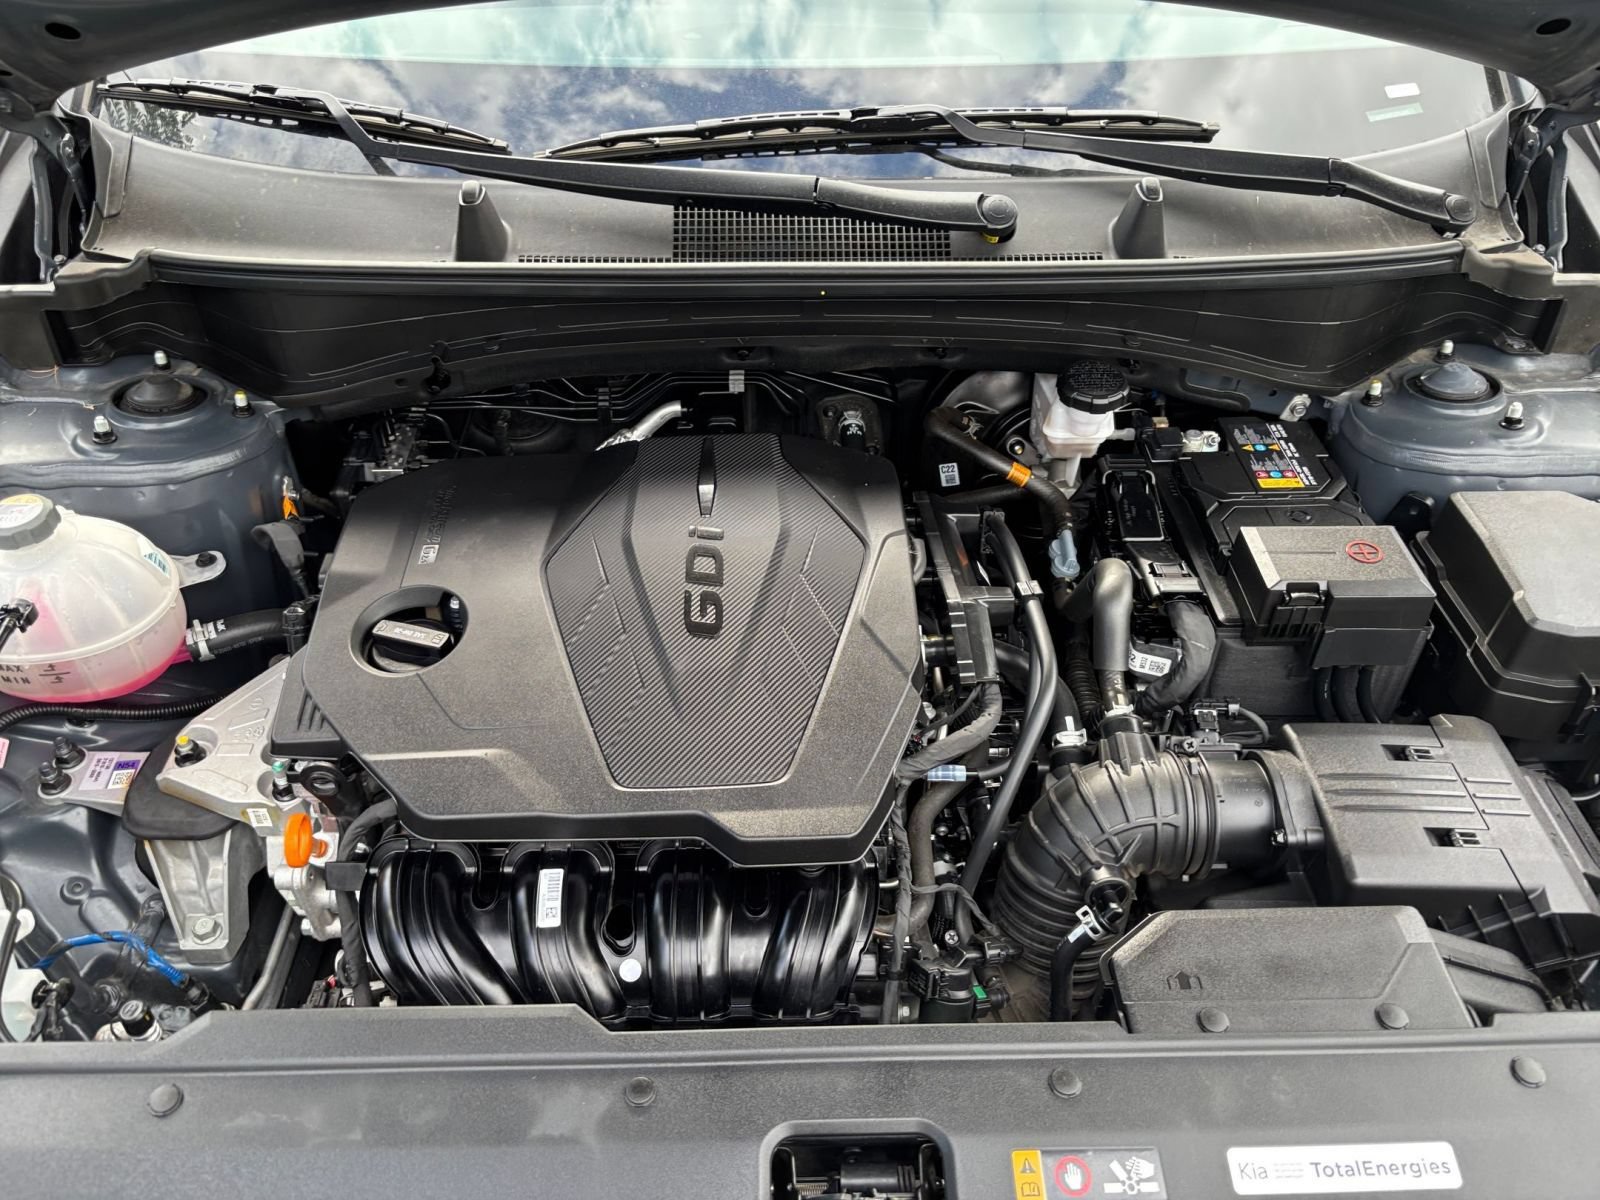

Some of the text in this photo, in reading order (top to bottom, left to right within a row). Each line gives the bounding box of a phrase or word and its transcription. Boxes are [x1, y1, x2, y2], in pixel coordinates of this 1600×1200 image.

[941, 464, 956, 474] C22
[683, 525, 724, 639] GDi
[1, 675, 31, 685] MIN
[117, 761, 136, 769] N54
[1238, 1161, 1269, 1180] Kia
[1309, 1158, 1452, 1179] TotalEnergies
